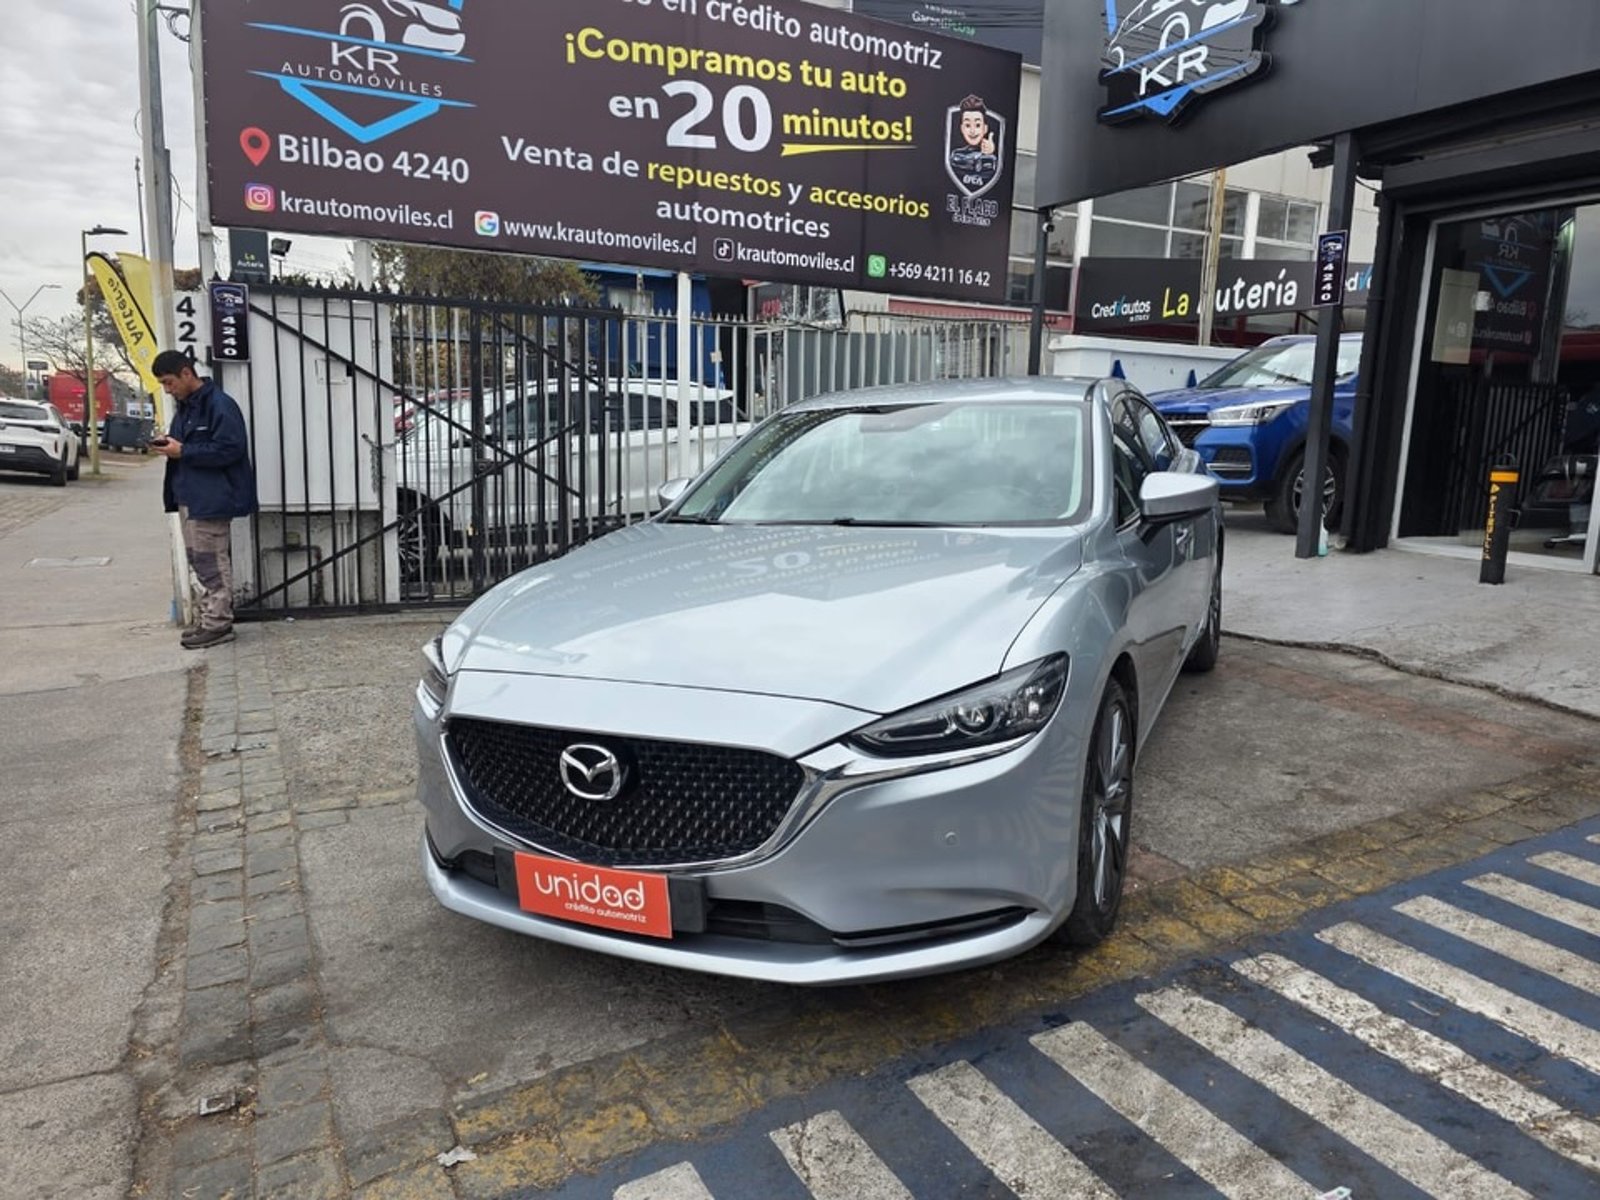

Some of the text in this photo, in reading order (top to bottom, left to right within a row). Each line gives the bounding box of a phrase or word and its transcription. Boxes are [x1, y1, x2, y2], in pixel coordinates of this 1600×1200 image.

[332, 41, 400, 75] KR
[705, 0, 801, 38] crédito
[809, 20, 942, 71] automotriz
[281, 61, 443, 98] AUTOMÓVILES
[565, 27, 906, 99] ¡Compramos tu auto
[1139, 45, 1209, 96] KR
[608, 79, 914, 153] en 20 minutos!
[278, 133, 470, 184] Bilbao 4240
[500, 136, 930, 219] Venta de repuestos y accesorios
[280, 191, 991, 287] krautomoviles.cl www.krautomoviles.cl krautomoviles.cl +569 4211 16 42
[656, 200, 831, 240] automotrices
[1162, 288, 1189, 318] La
[1197, 268, 1298, 314] utería
[534, 871, 645, 911] unidad
[597, 907, 647, 923] automotriz
